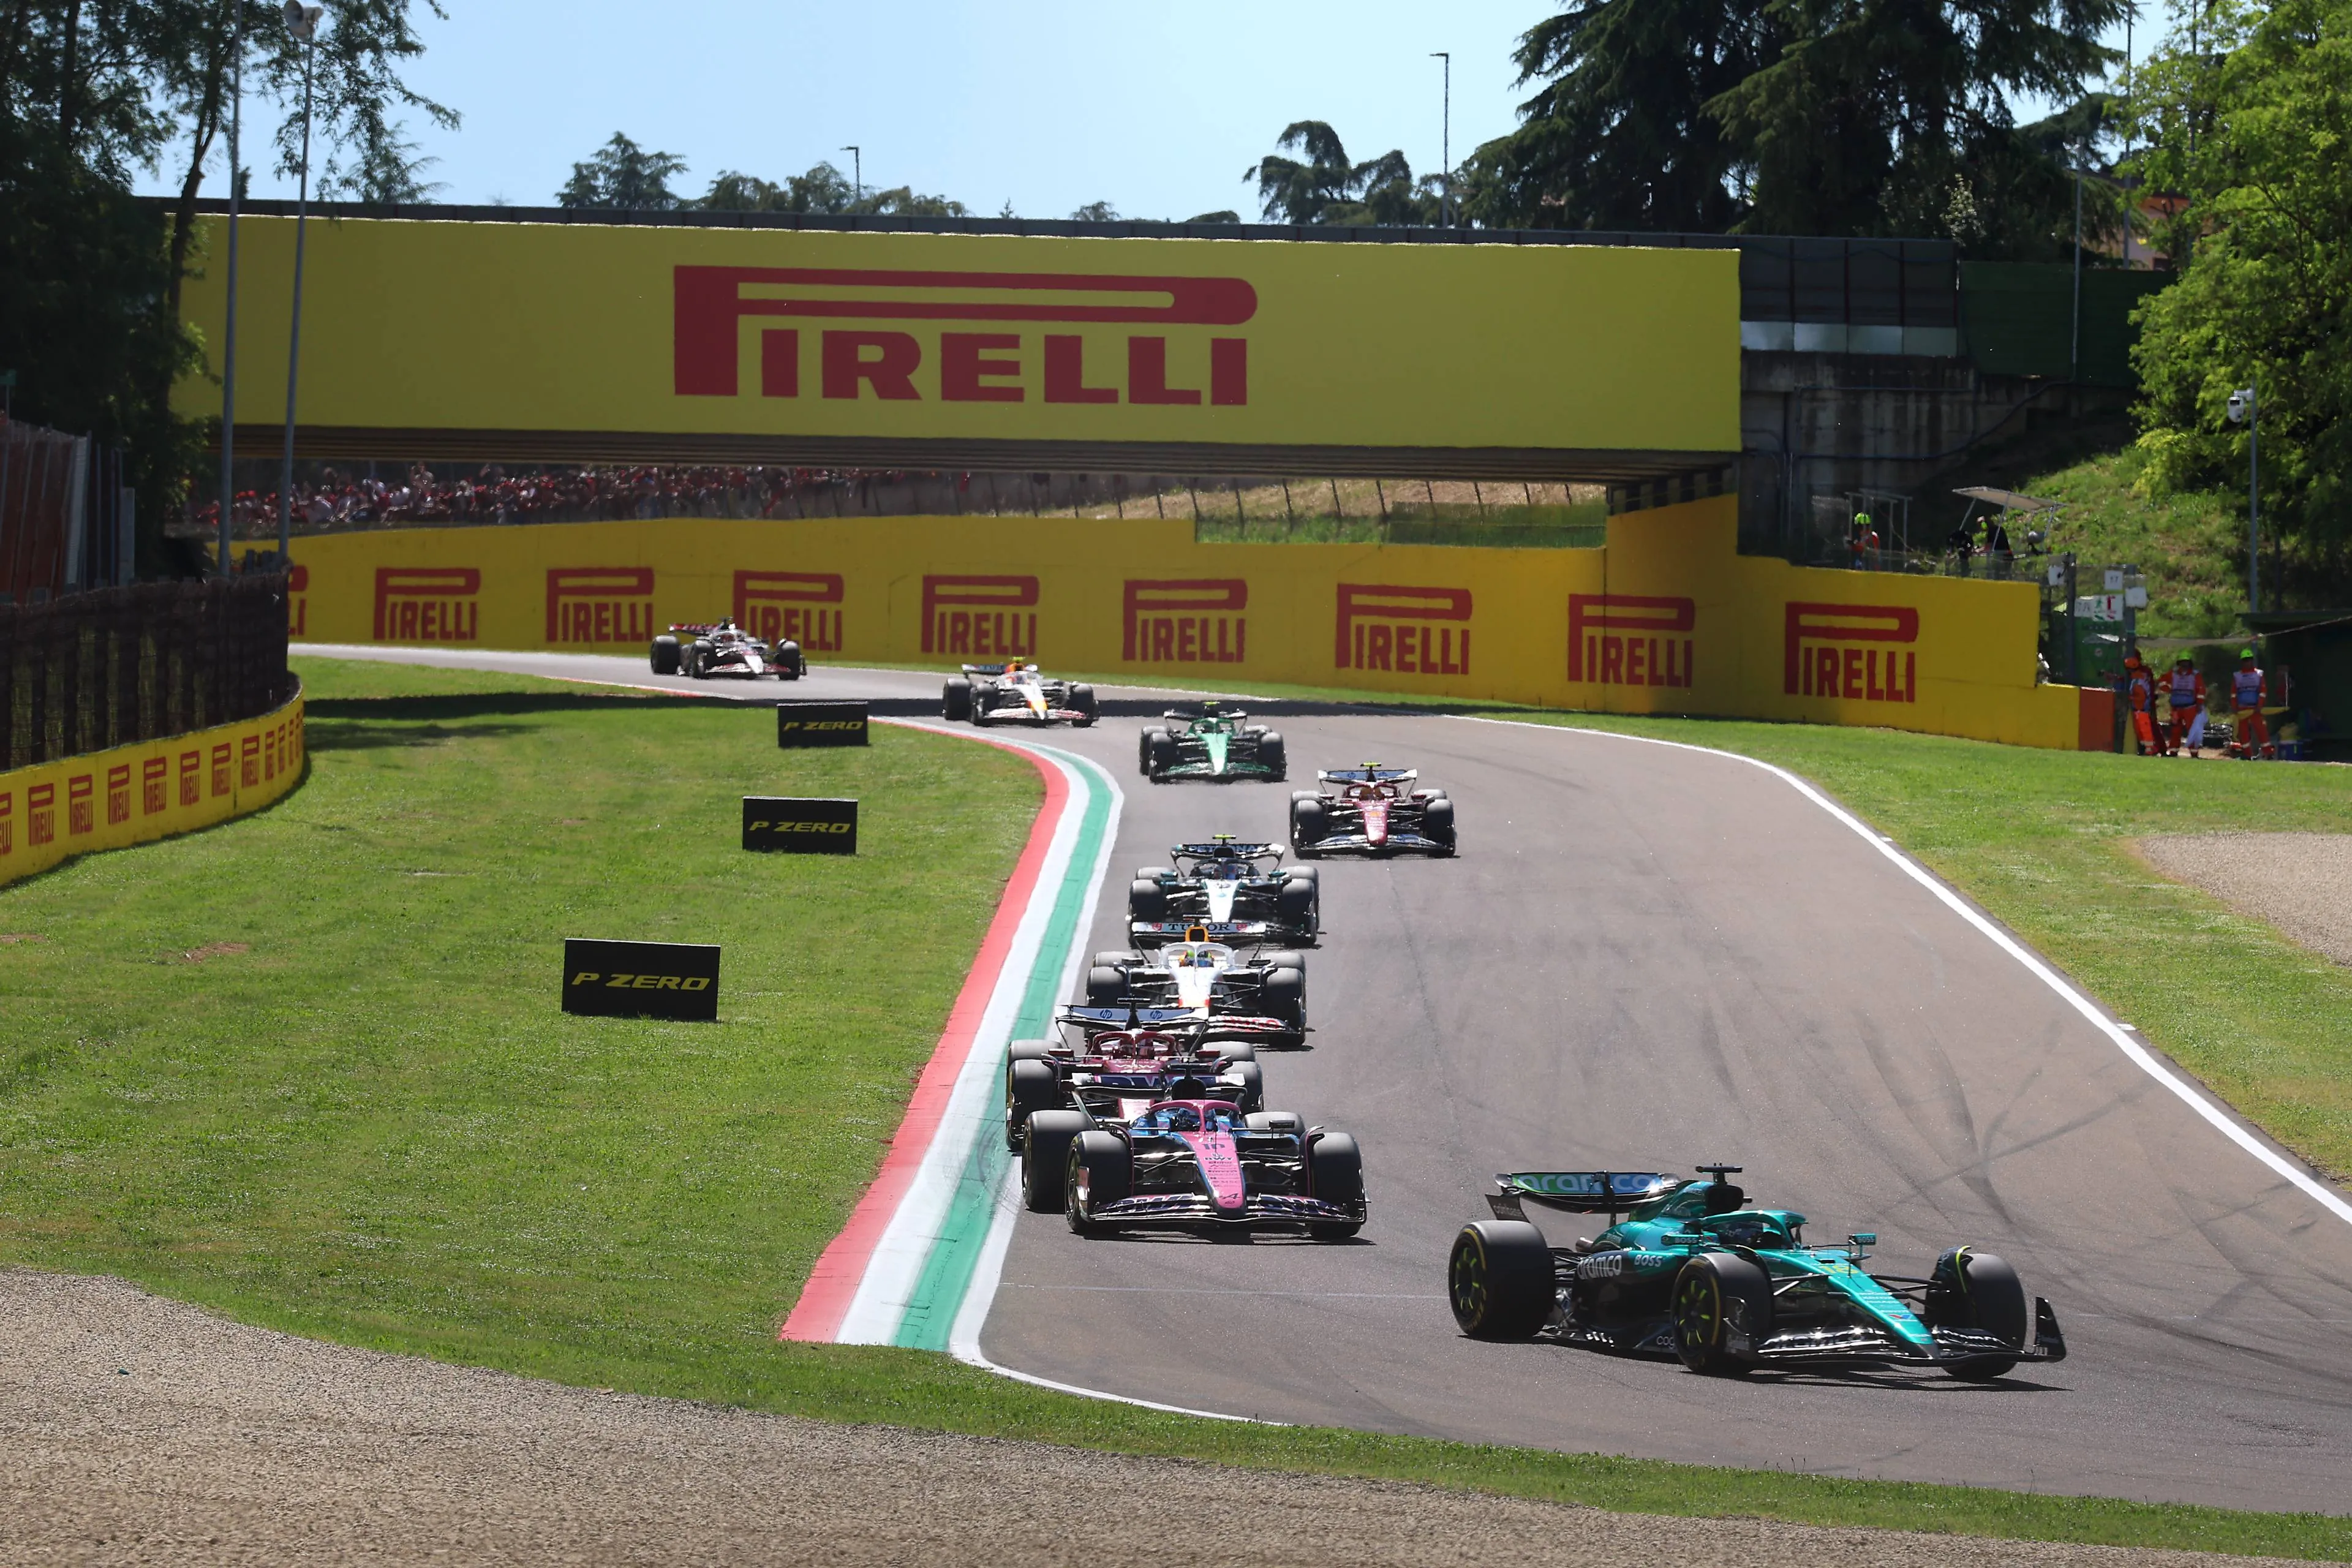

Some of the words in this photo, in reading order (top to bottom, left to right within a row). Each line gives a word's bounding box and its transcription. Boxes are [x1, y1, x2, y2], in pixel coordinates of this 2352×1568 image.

[674, 266, 1257, 405] PIRELLI
[374, 567, 480, 640] PIRELLI
[547, 567, 654, 643] PIRELLI
[733, 570, 843, 651] PIRELLI
[921, 575, 1039, 655] PIRELLI
[1123, 579, 1248, 662] PIRELLI
[1335, 583, 1473, 675] PIRELLI
[1567, 593, 1695, 688] PIRELLI
[1785, 602, 1920, 703] PIRELLI
[784, 722, 799, 731] P
[802, 721, 863, 730] ZERO
[750, 821, 769, 831] P
[774, 822, 851, 834] ZERO
[571, 972, 600, 985] P
[605, 974, 710, 990] ZERO
[1577, 1255, 1622, 1280] aramco
[1634, 1254, 1663, 1267] BOSS
